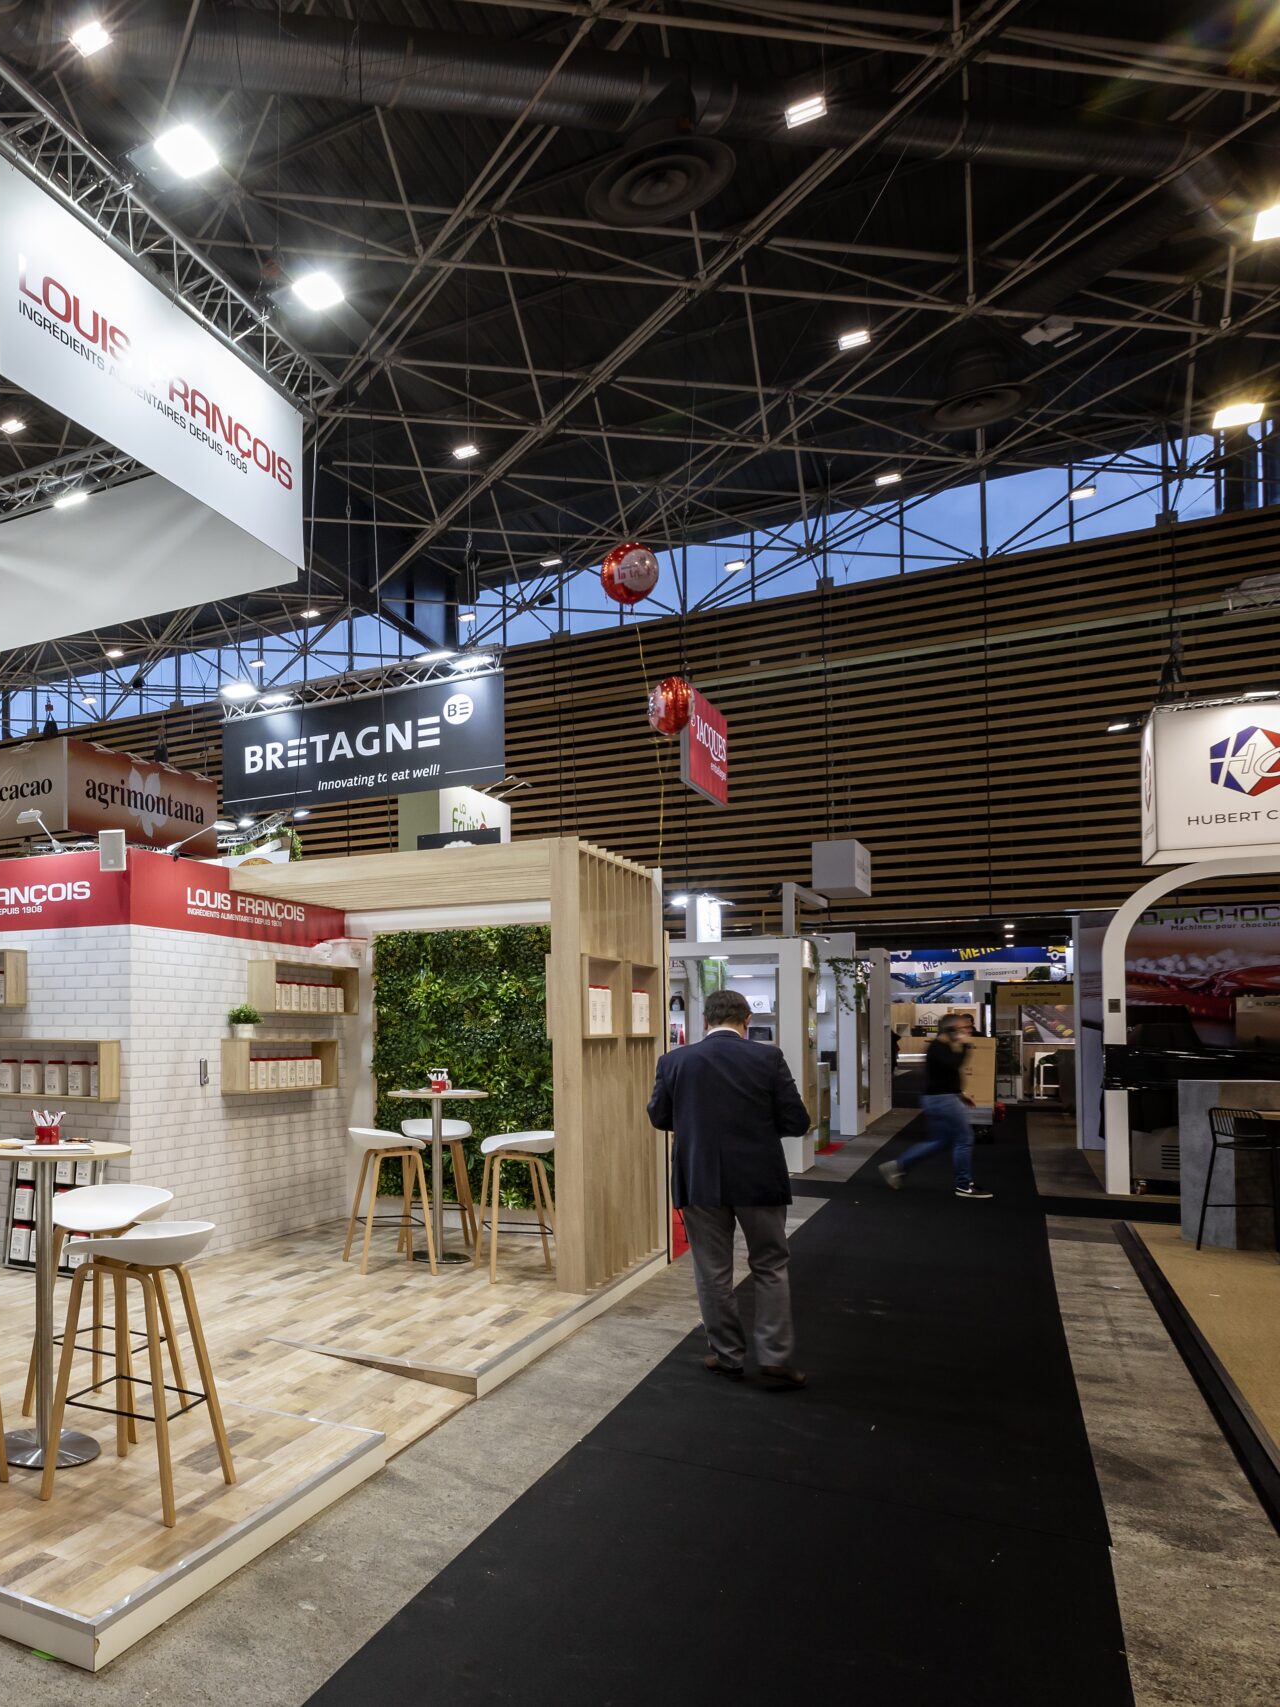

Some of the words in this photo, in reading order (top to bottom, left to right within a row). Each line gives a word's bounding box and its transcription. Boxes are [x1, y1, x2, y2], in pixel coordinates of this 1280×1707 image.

[19, 253, 131, 362] LOUIS
[161, 371, 293, 490] RANÇOIS
[19, 299, 105, 371] INGRÉDIENTS
[108, 364, 186, 430] AENTAIRES
[189, 423, 223, 456] DEPUIS
[225, 449, 248, 474] 1908
[244, 716, 441, 775] BRETAGNE
[696, 715, 727, 762] JACQUES
[317, 773, 375, 792] Innovating
[391, 769, 410, 783] eat
[412, 764, 441, 779] well!
[85, 778, 205, 825] agrimontana
[1187, 810, 1261, 826] HUBERT
[22, 904, 42, 914] 1908
[187, 887, 231, 910] LOUIS
[237, 896, 305, 922] FRANÇOIS
[1171, 924, 1211, 932] Machines
[1215, 923, 1237, 931] pour
[960, 947, 1002, 961] METR
